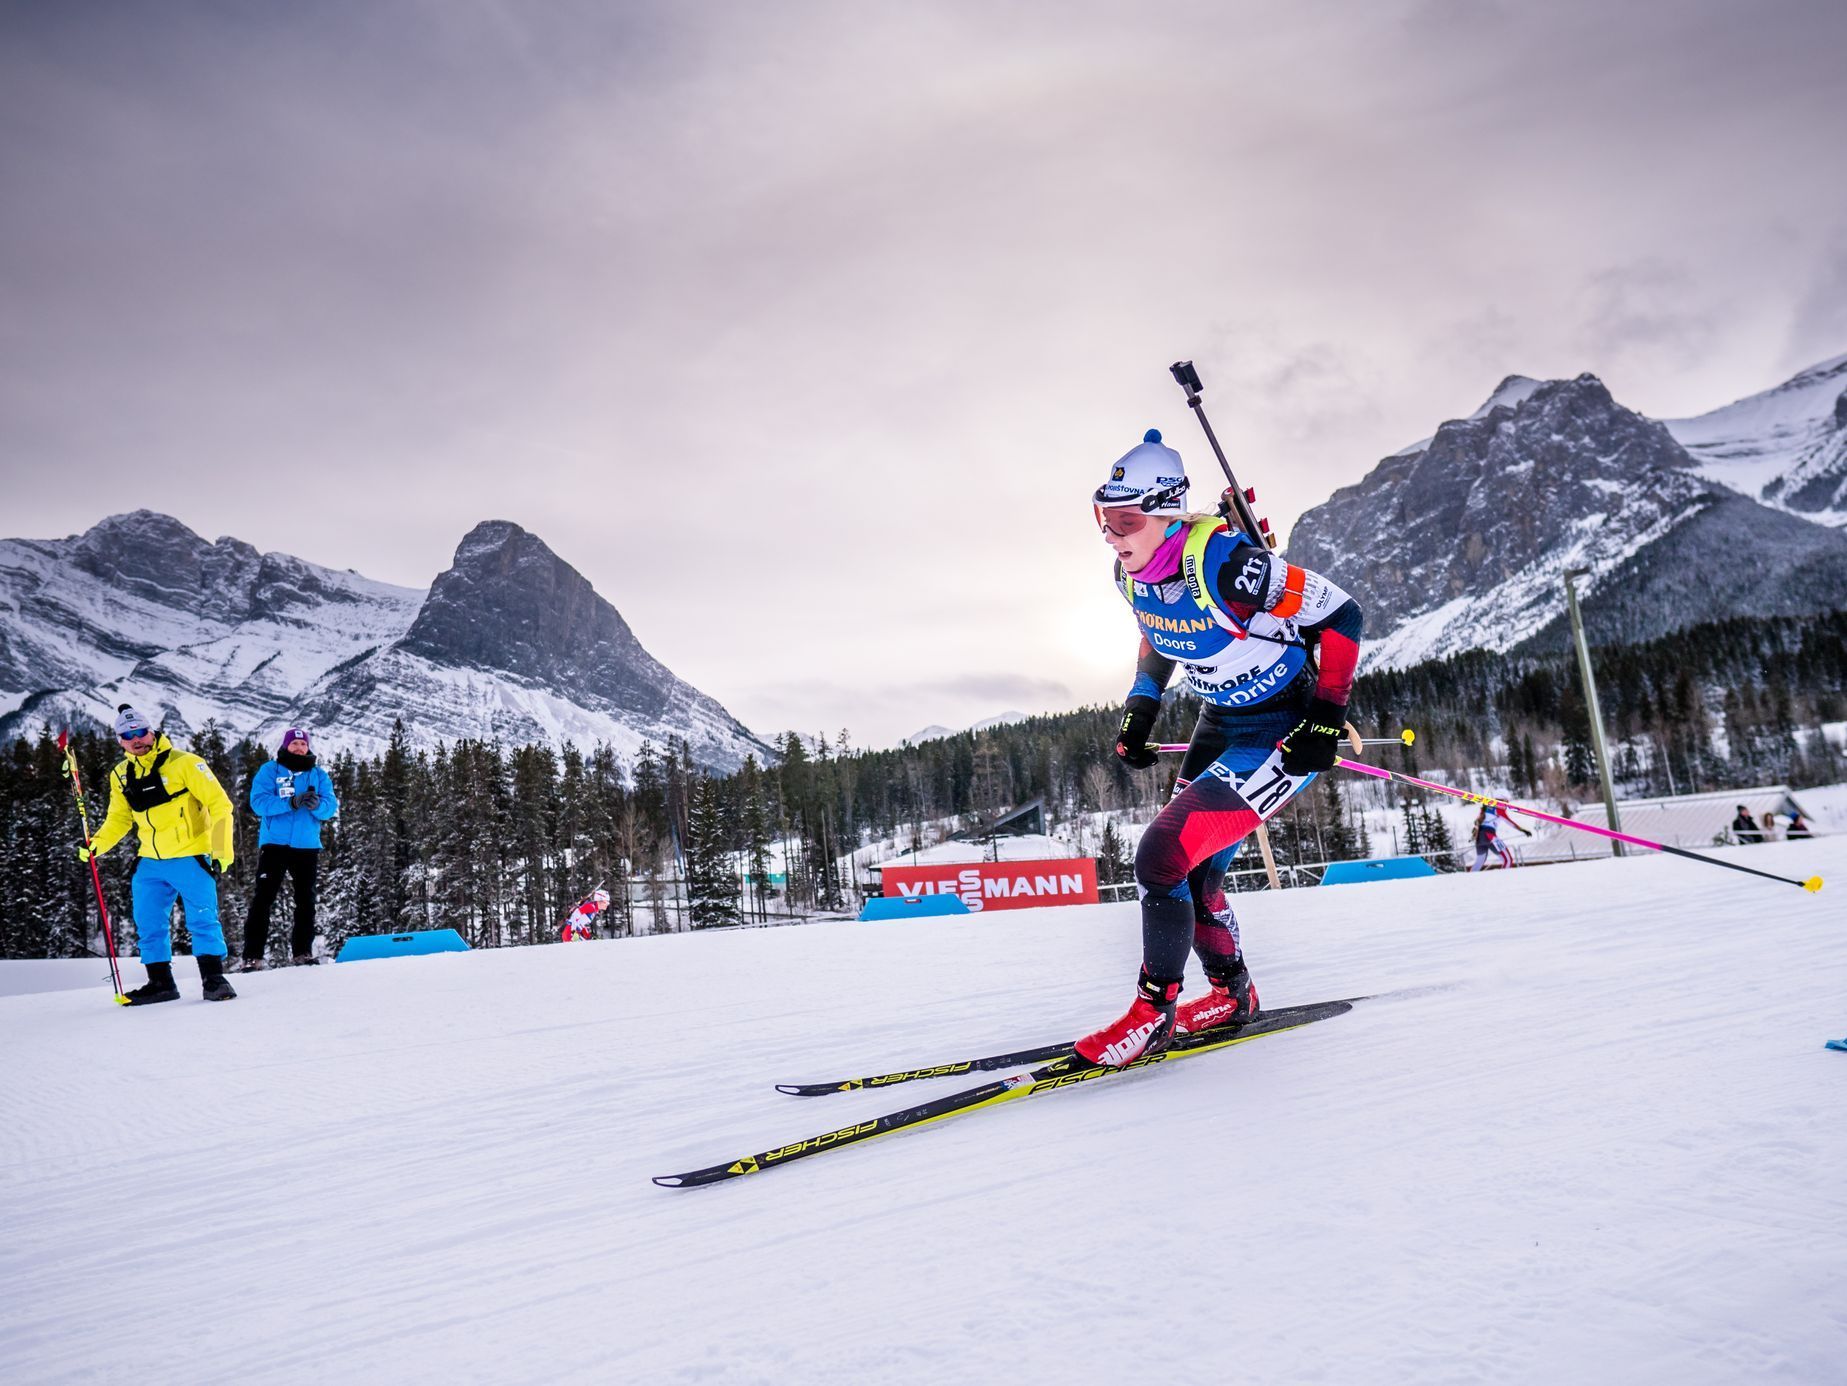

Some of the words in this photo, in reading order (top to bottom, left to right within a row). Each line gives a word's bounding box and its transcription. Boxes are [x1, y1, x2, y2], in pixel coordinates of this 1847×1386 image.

[1165, 486, 1185, 500] Julbo
[1186, 557, 1200, 597] meopta
[1154, 633, 1196, 650] Doors
[1314, 724, 1340, 737] LEKI
[1207, 761, 1246, 791] EX
[1246, 765, 1292, 814] 78
[897, 870, 1084, 912] VIESSMANN
[1192, 1003, 1232, 1021] alpina
[871, 1061, 972, 1085] FISCHER
[1029, 1054, 1167, 1095] FISCHER
[765, 1119, 878, 1161] FISCHER
